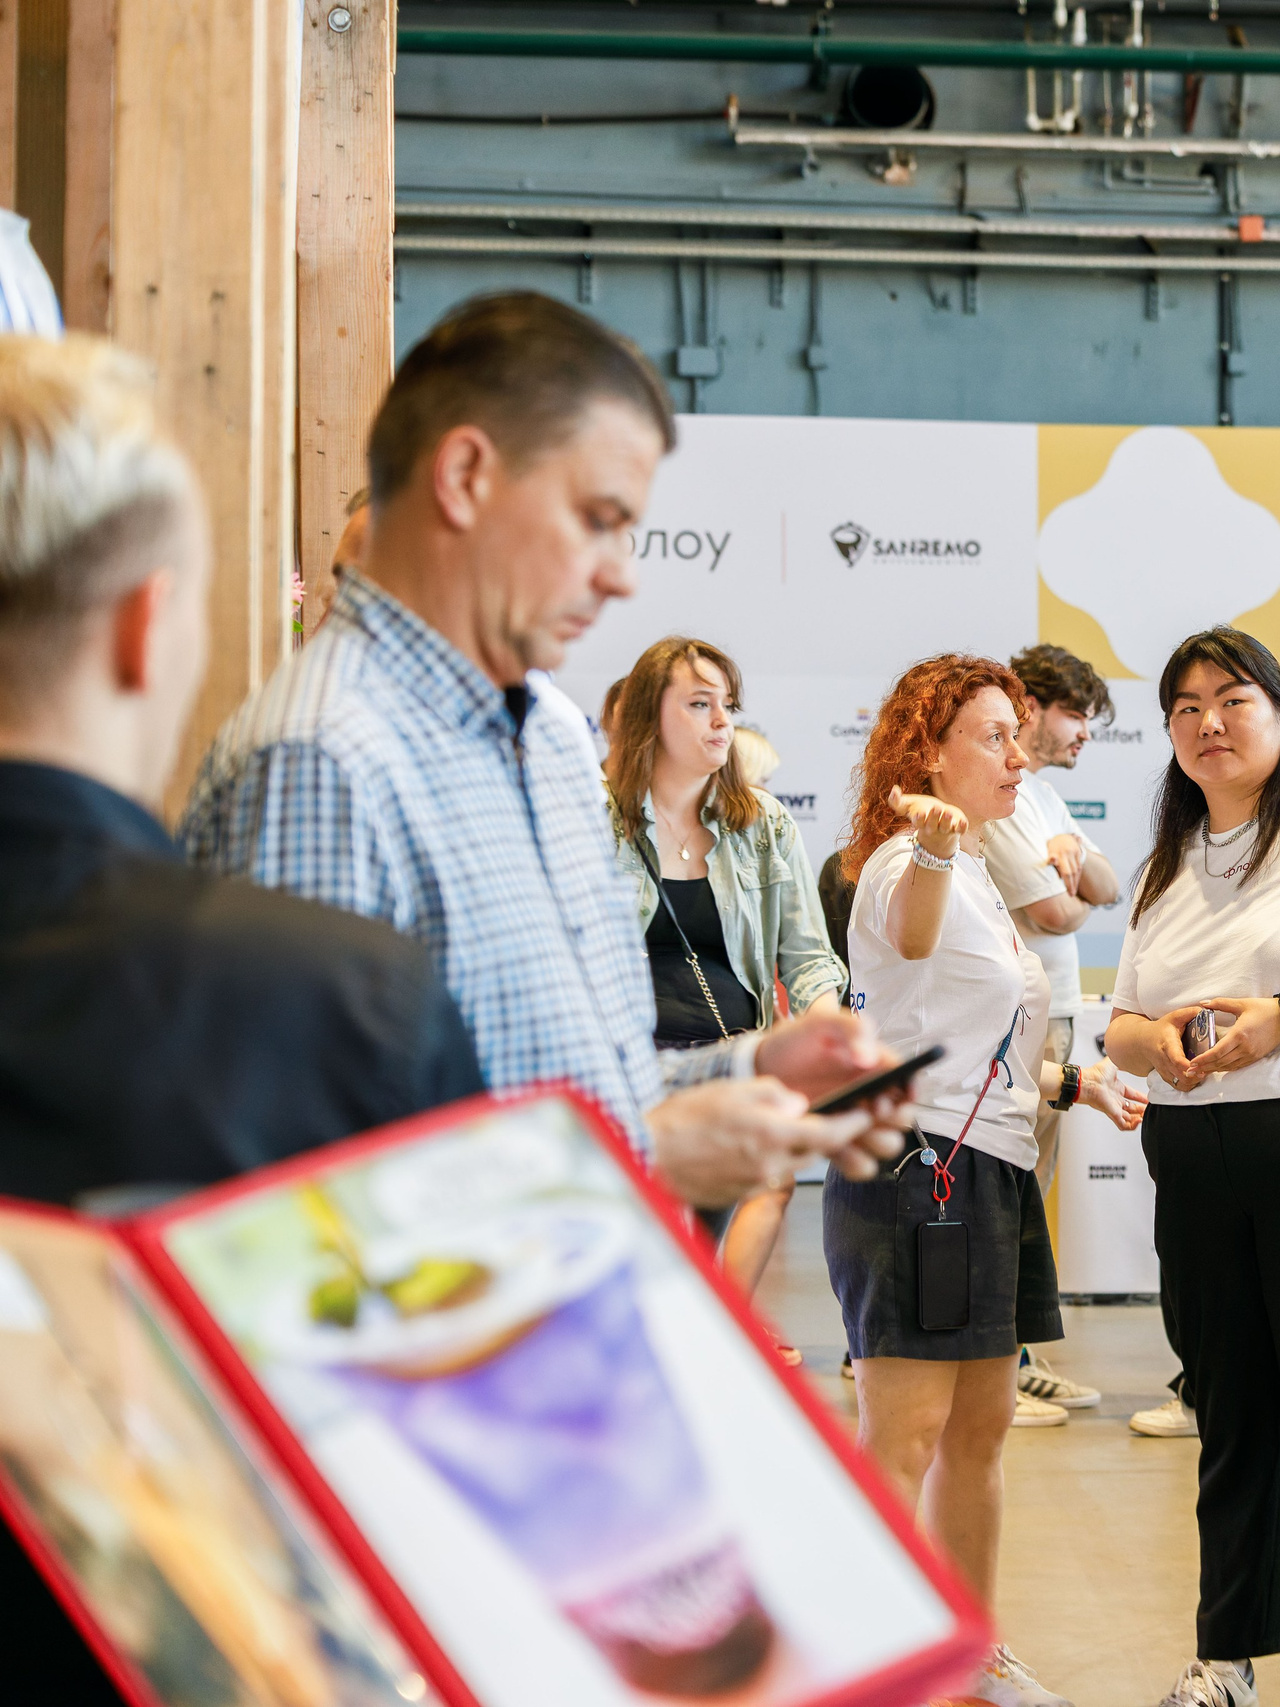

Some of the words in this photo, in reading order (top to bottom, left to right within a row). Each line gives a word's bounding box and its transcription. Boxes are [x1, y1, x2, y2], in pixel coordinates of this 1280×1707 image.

[628, 529, 732, 573] лоу
[872, 539, 982, 557] SANREMO
[1223, 862, 1251, 880] фло
